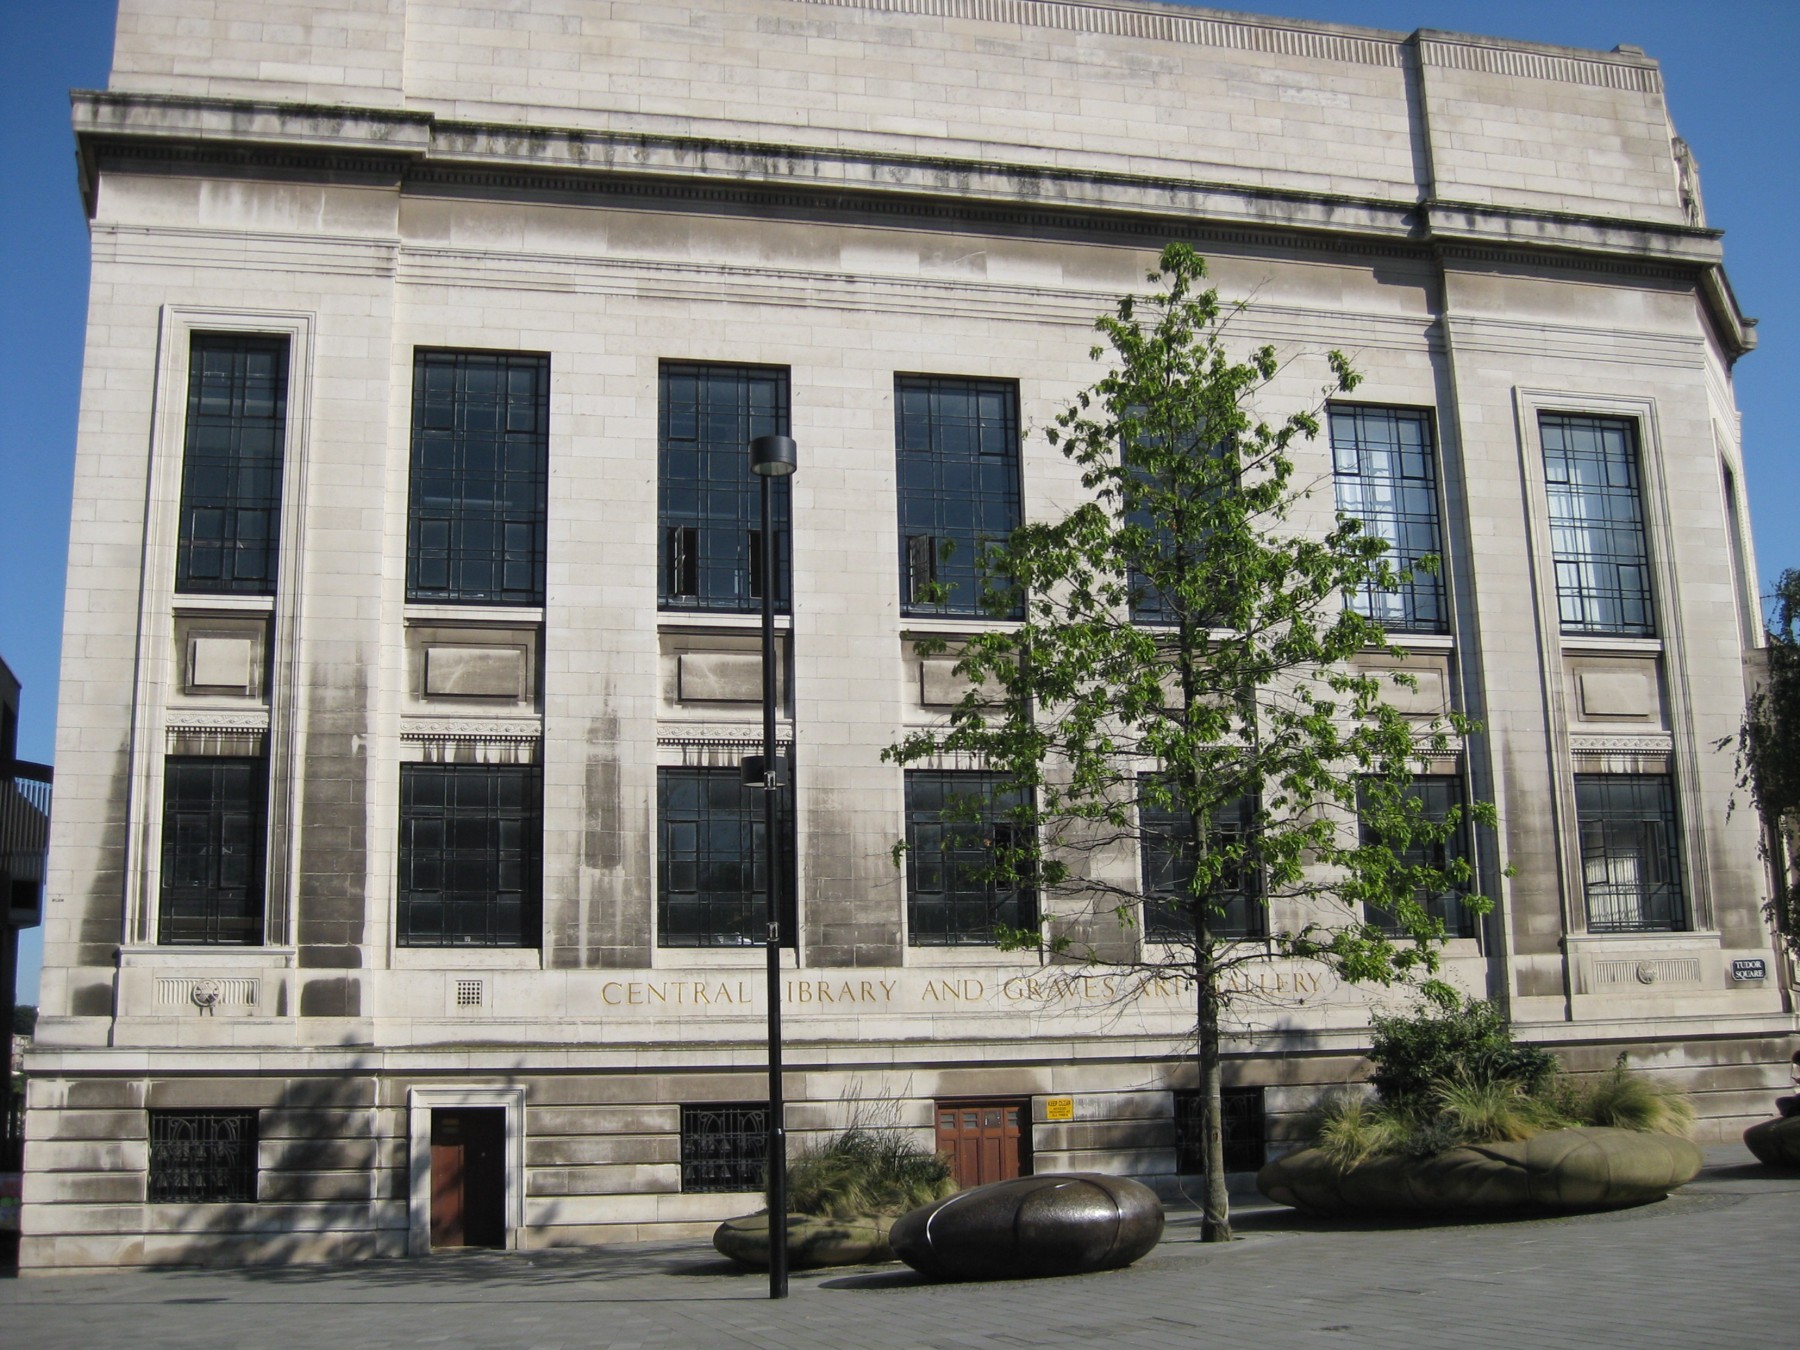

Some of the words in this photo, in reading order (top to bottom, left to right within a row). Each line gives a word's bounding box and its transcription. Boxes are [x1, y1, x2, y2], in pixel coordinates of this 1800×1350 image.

[1735, 961, 1762, 969] TUDOR
[1735, 970, 1763, 978] SQUARE
[601, 981, 752, 1005] CENTRAL
[780, 980, 897, 1003] IBRARY
[921, 979, 984, 1001] AND
[1003, 976, 1115, 1000] GRAVES
[1132, 976, 1181, 997] ART
